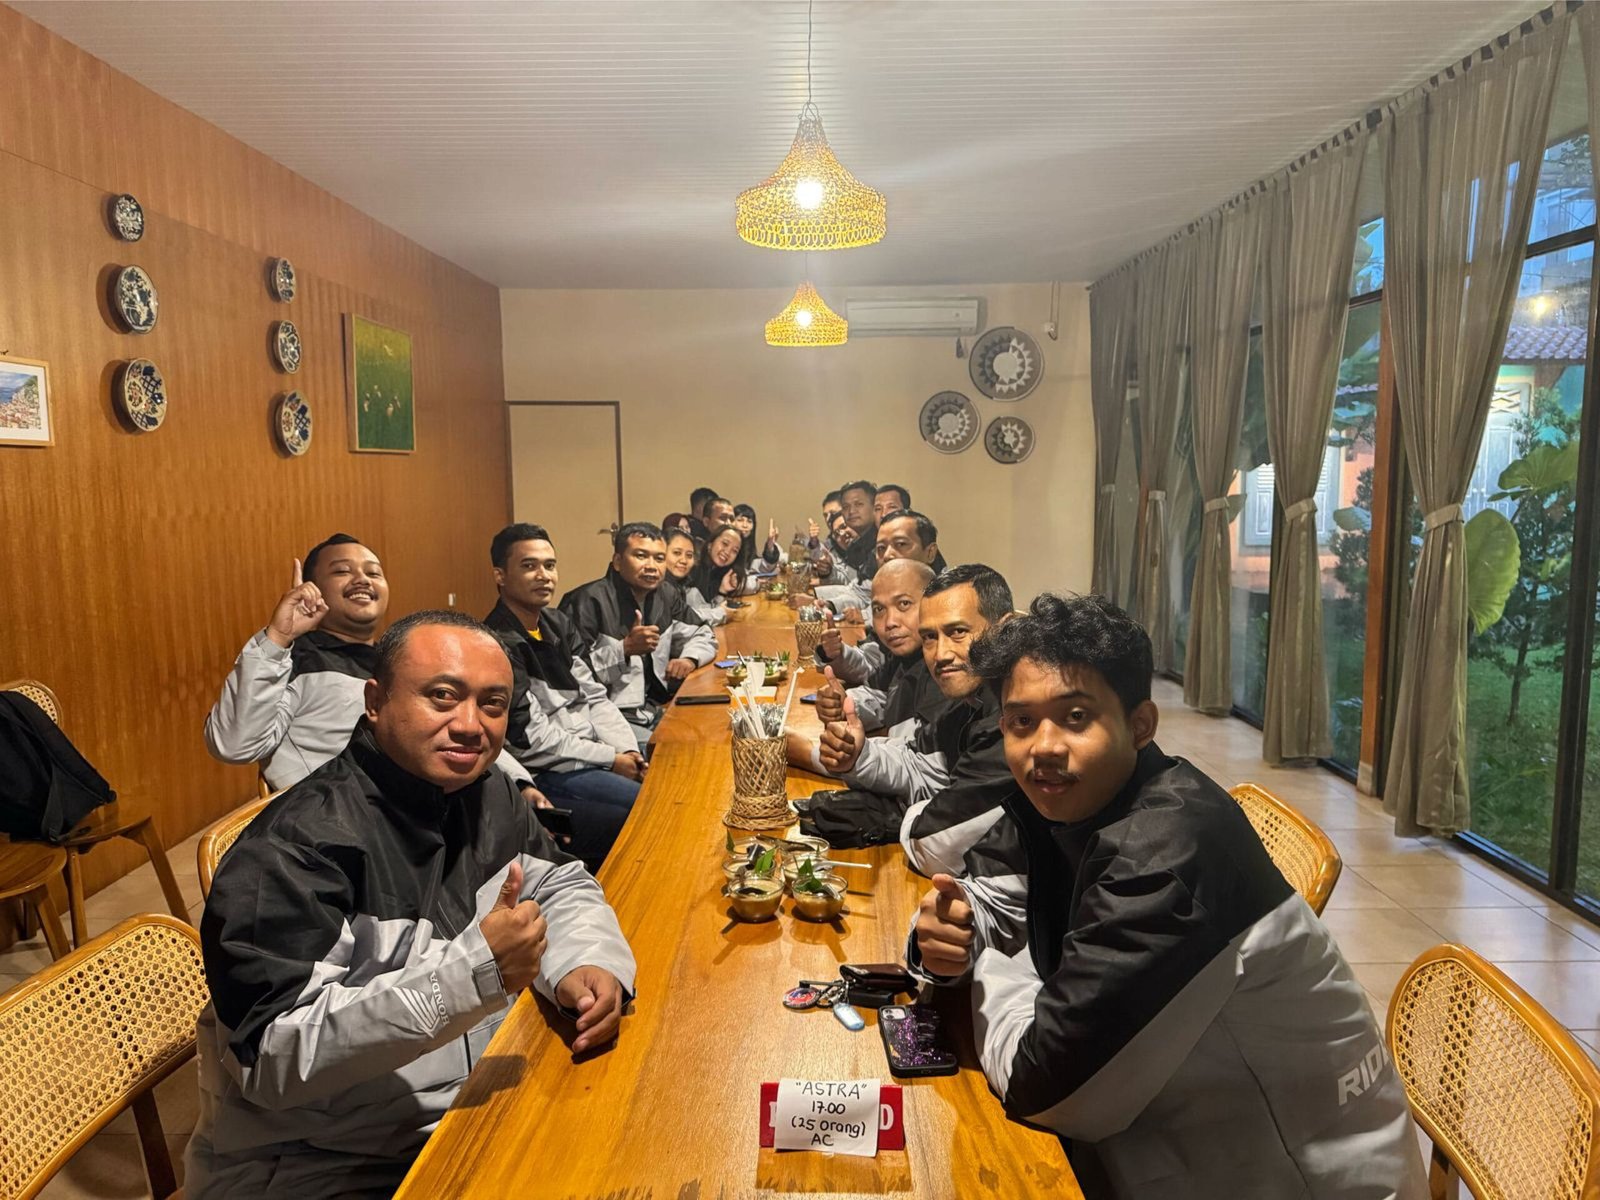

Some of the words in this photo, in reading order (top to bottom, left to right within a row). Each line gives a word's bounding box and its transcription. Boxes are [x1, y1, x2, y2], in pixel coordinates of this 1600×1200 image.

[812, 1101, 846, 1115] 17.00
[791, 1115, 815, 1131] (25
[811, 1133, 835, 1146] AC
